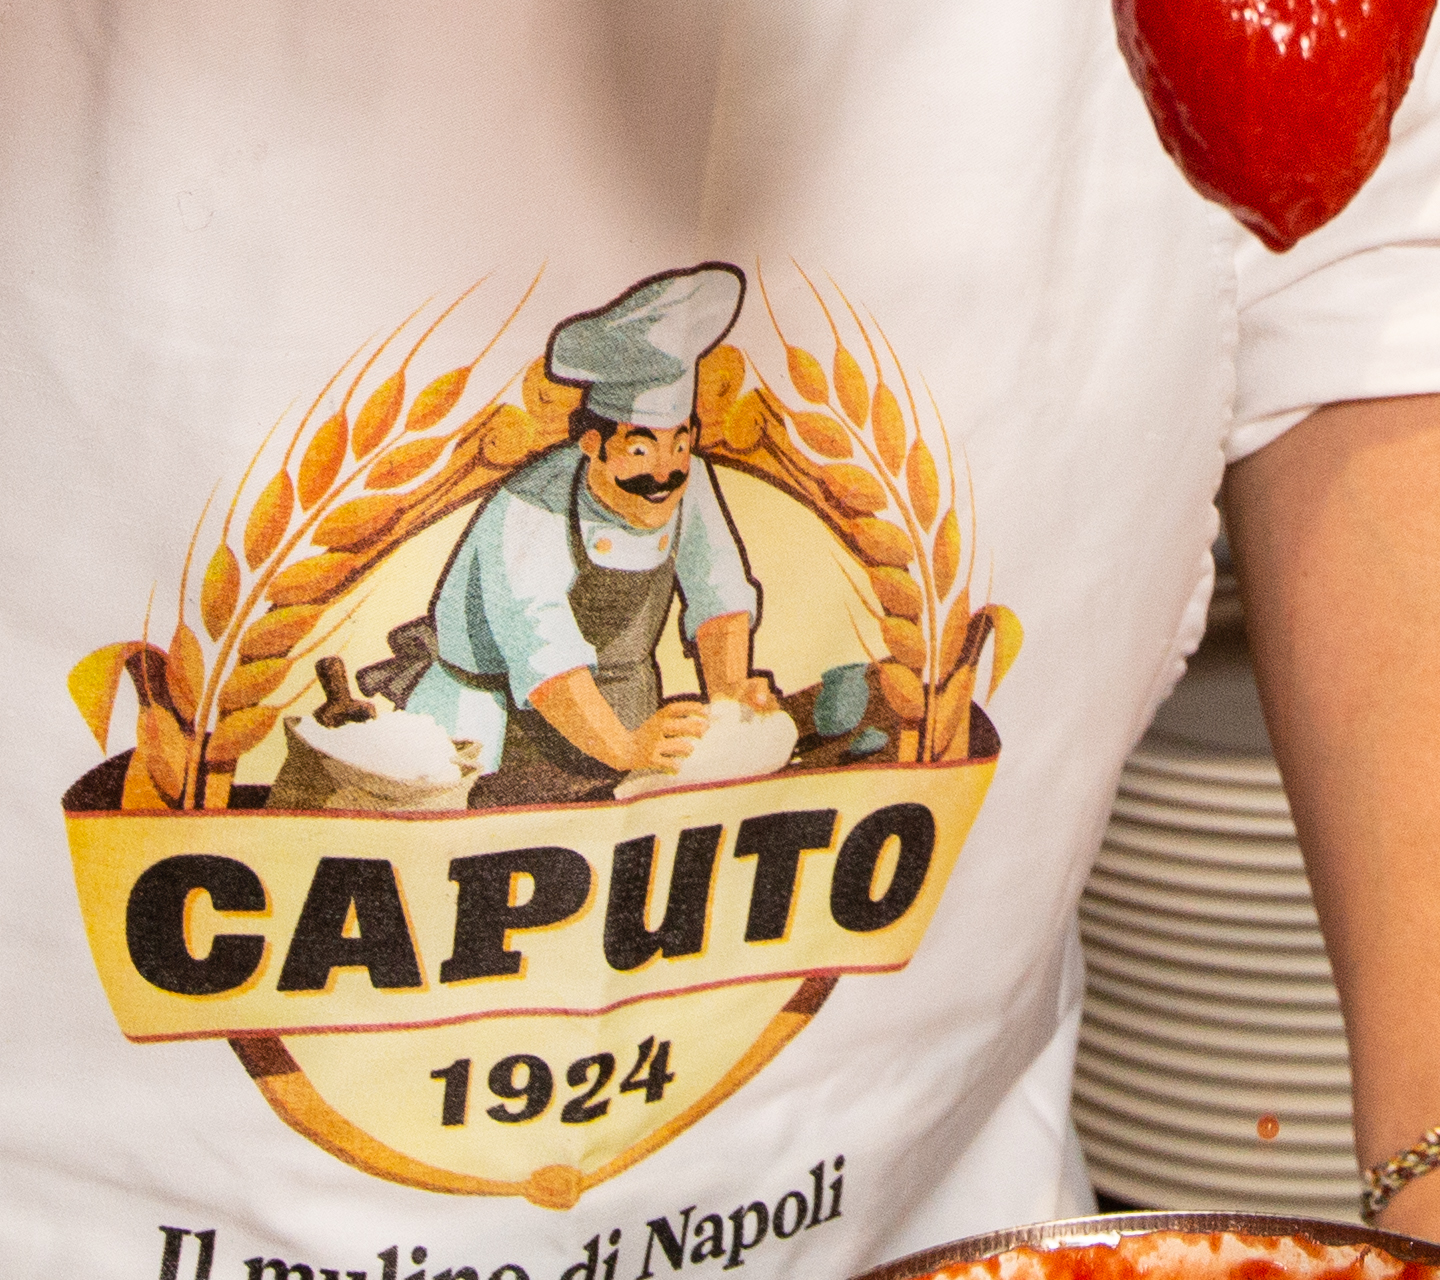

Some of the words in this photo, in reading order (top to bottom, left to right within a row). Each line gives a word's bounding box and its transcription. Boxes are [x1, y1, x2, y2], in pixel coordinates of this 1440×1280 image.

[124, 801, 938, 997] CAPUTO
[428, 1035, 676, 1127] 1924
[559, 1227, 622, 1280] di
[634, 1154, 846, 1280] Napoli
